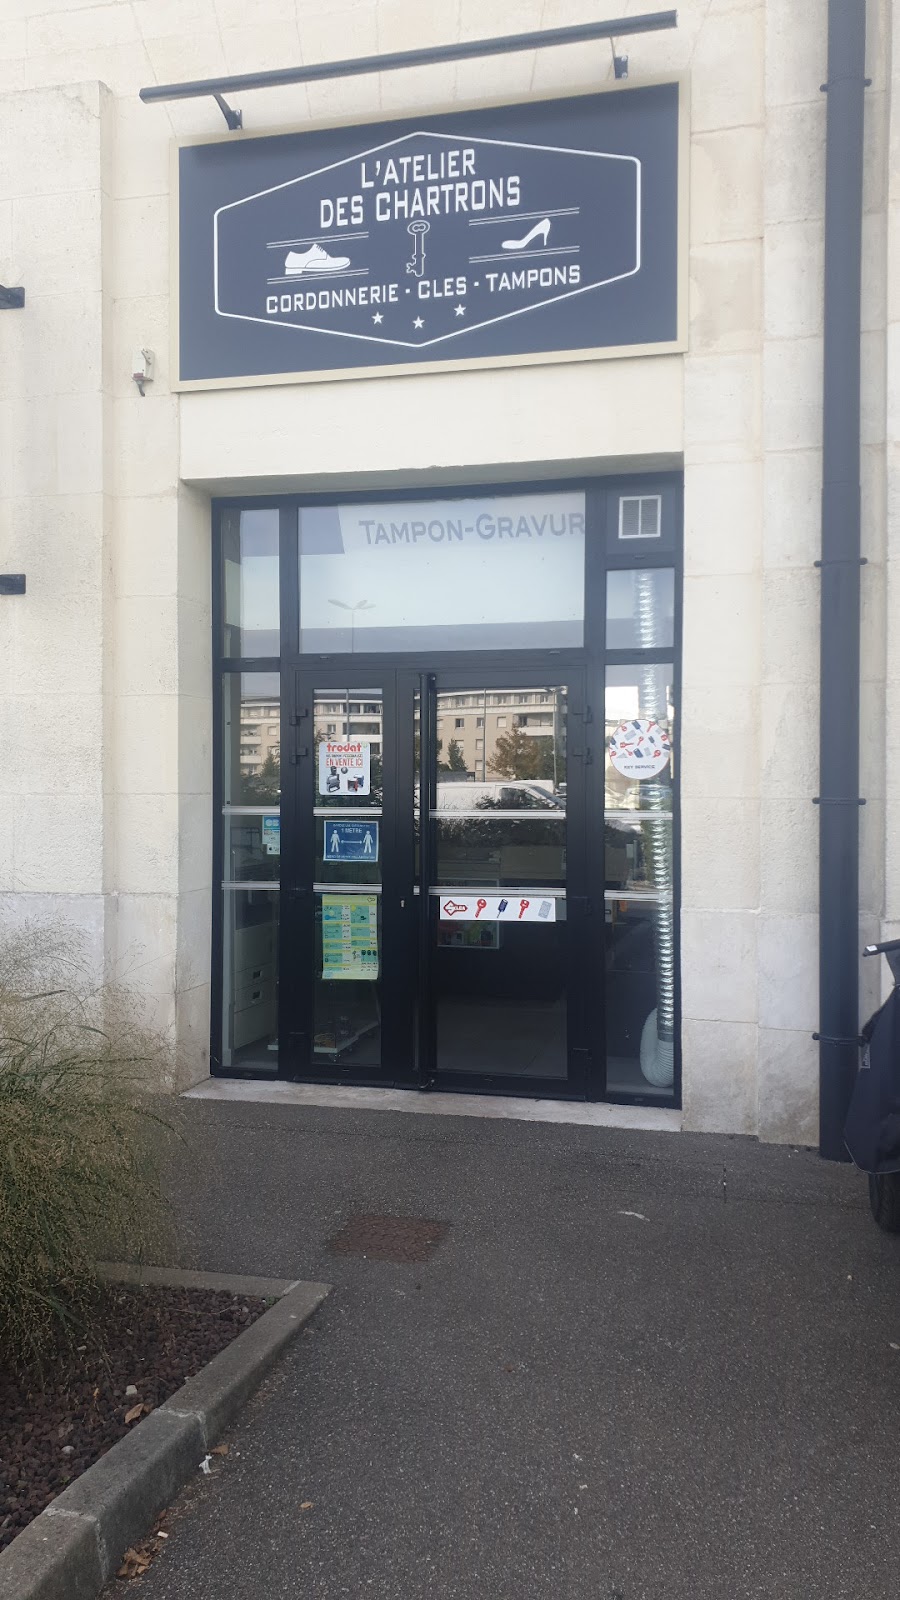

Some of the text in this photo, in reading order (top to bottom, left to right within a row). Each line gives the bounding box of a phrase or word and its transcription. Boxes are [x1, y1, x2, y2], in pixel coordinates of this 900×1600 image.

[360, 148, 477, 189] L'ATELIER
[320, 175, 520, 229] DES CHARTRONS
[266, 264, 581, 314] CORDONNERIE CLES TAMPONS
[326, 742, 362, 752] trodat
[335, 758, 354, 766] VENTE
